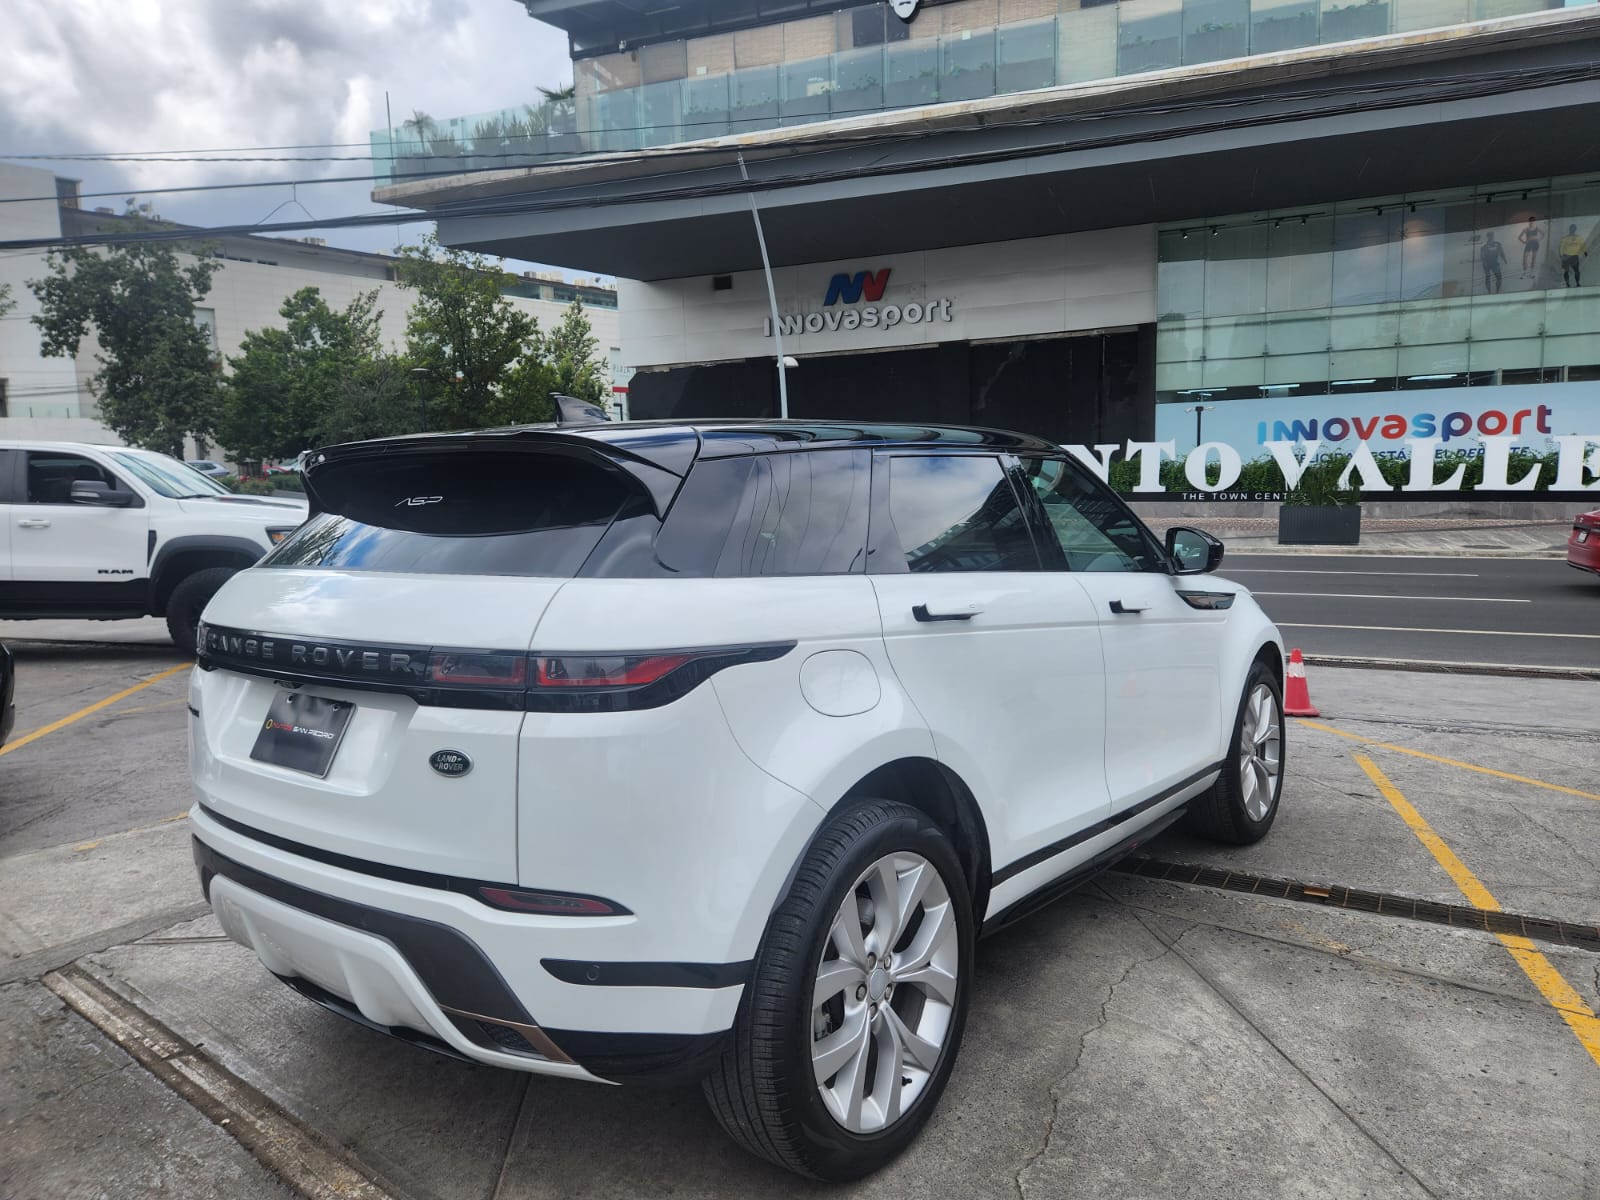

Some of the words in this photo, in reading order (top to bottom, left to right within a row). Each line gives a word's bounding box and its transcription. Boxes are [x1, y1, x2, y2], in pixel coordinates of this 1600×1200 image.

[1263, 435, 1600, 492] VALLE
[1455, 446, 1530, 459] DEPTE
[1183, 492, 1205, 500] THE
[1213, 492, 1248, 500] TOWN
[1254, 492, 1292, 500] CENT
[206, 632, 275, 659] RANGE
[291, 644, 411, 673] ROVER
